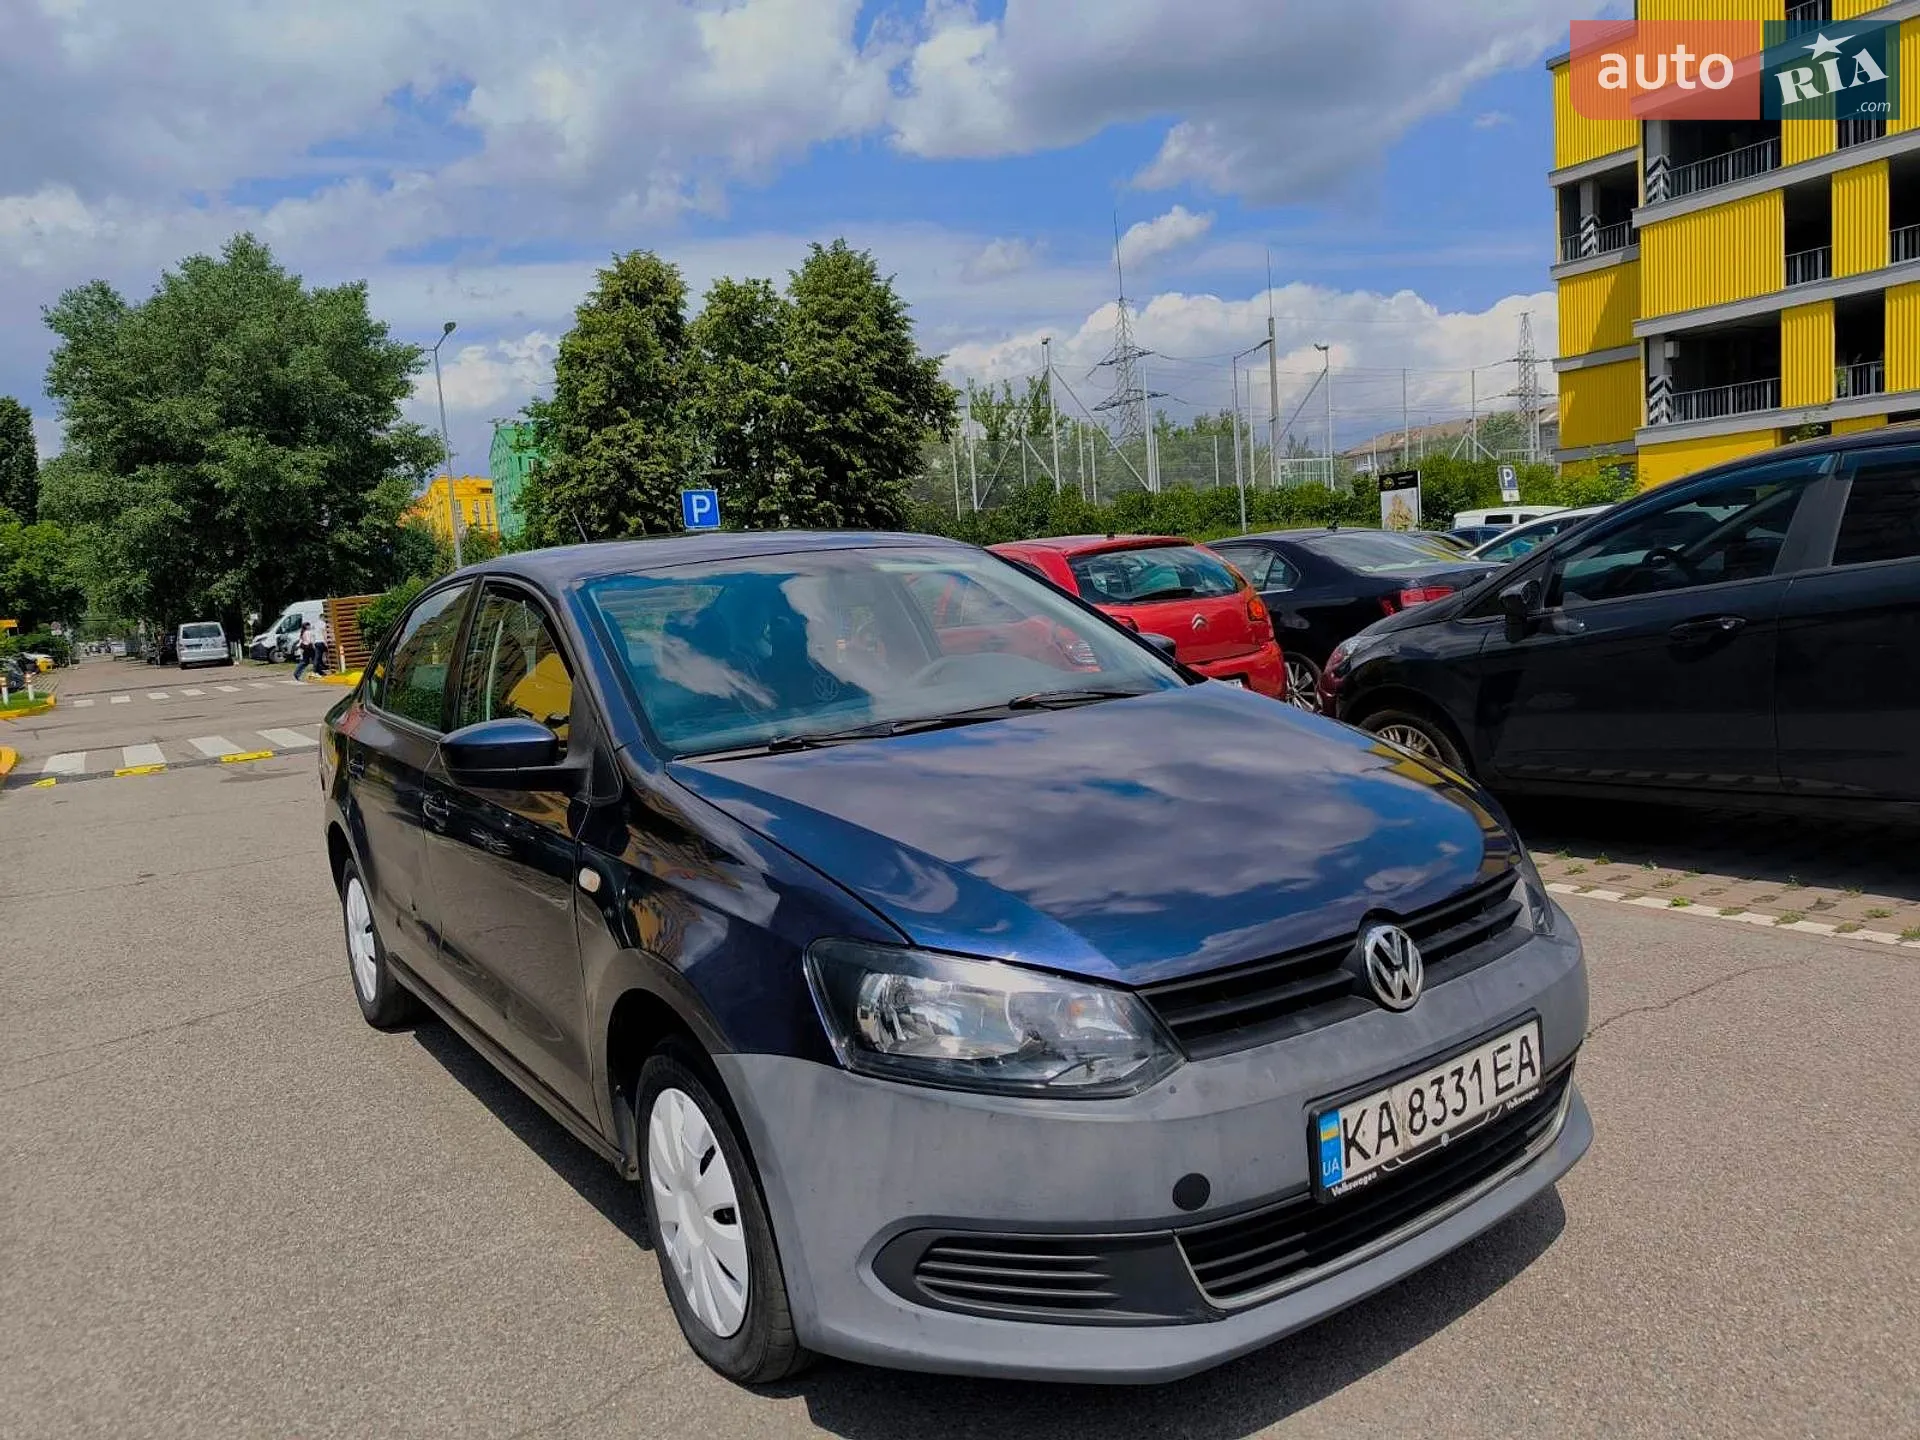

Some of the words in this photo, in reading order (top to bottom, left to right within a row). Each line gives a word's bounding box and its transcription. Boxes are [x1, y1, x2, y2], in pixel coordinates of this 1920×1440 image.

[1503, 468, 1513, 488] P
[691, 494, 711, 523] P
[1343, 1101, 1399, 1168] KA
[1408, 1058, 1484, 1136] 8331
[1492, 1035, 1536, 1097] EA
[1322, 1157, 1341, 1177] UA
